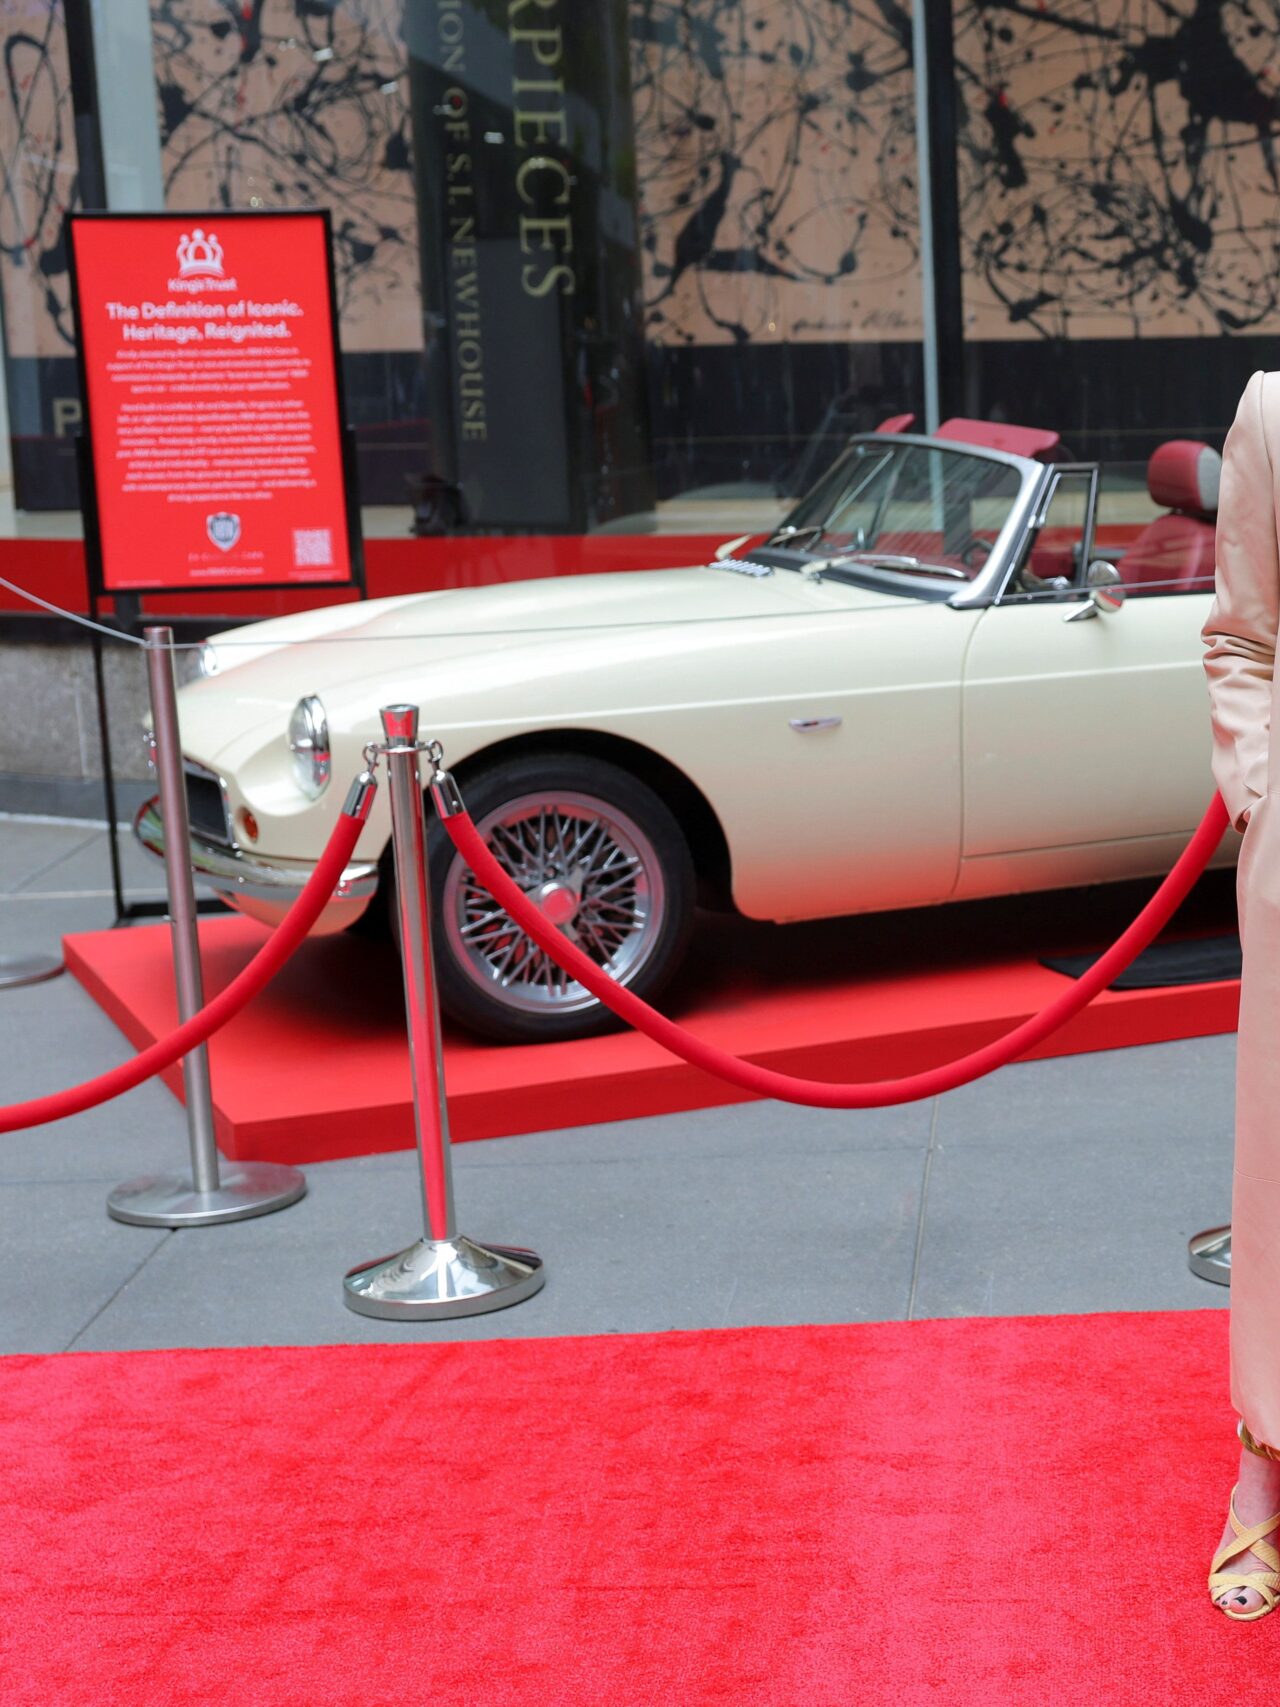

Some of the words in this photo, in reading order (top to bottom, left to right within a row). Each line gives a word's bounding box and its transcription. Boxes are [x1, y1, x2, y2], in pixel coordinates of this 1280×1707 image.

[442, 87, 470, 143] OF
[205, 277, 238, 292] Trust
[106, 302, 140, 319] The
[142, 301, 225, 319] Definition
[227, 300, 245, 317] of
[247, 299, 304, 317] Iconic.
[204, 320, 292, 343] Reignited.
[449, 217, 488, 441] NEWHOUSE
